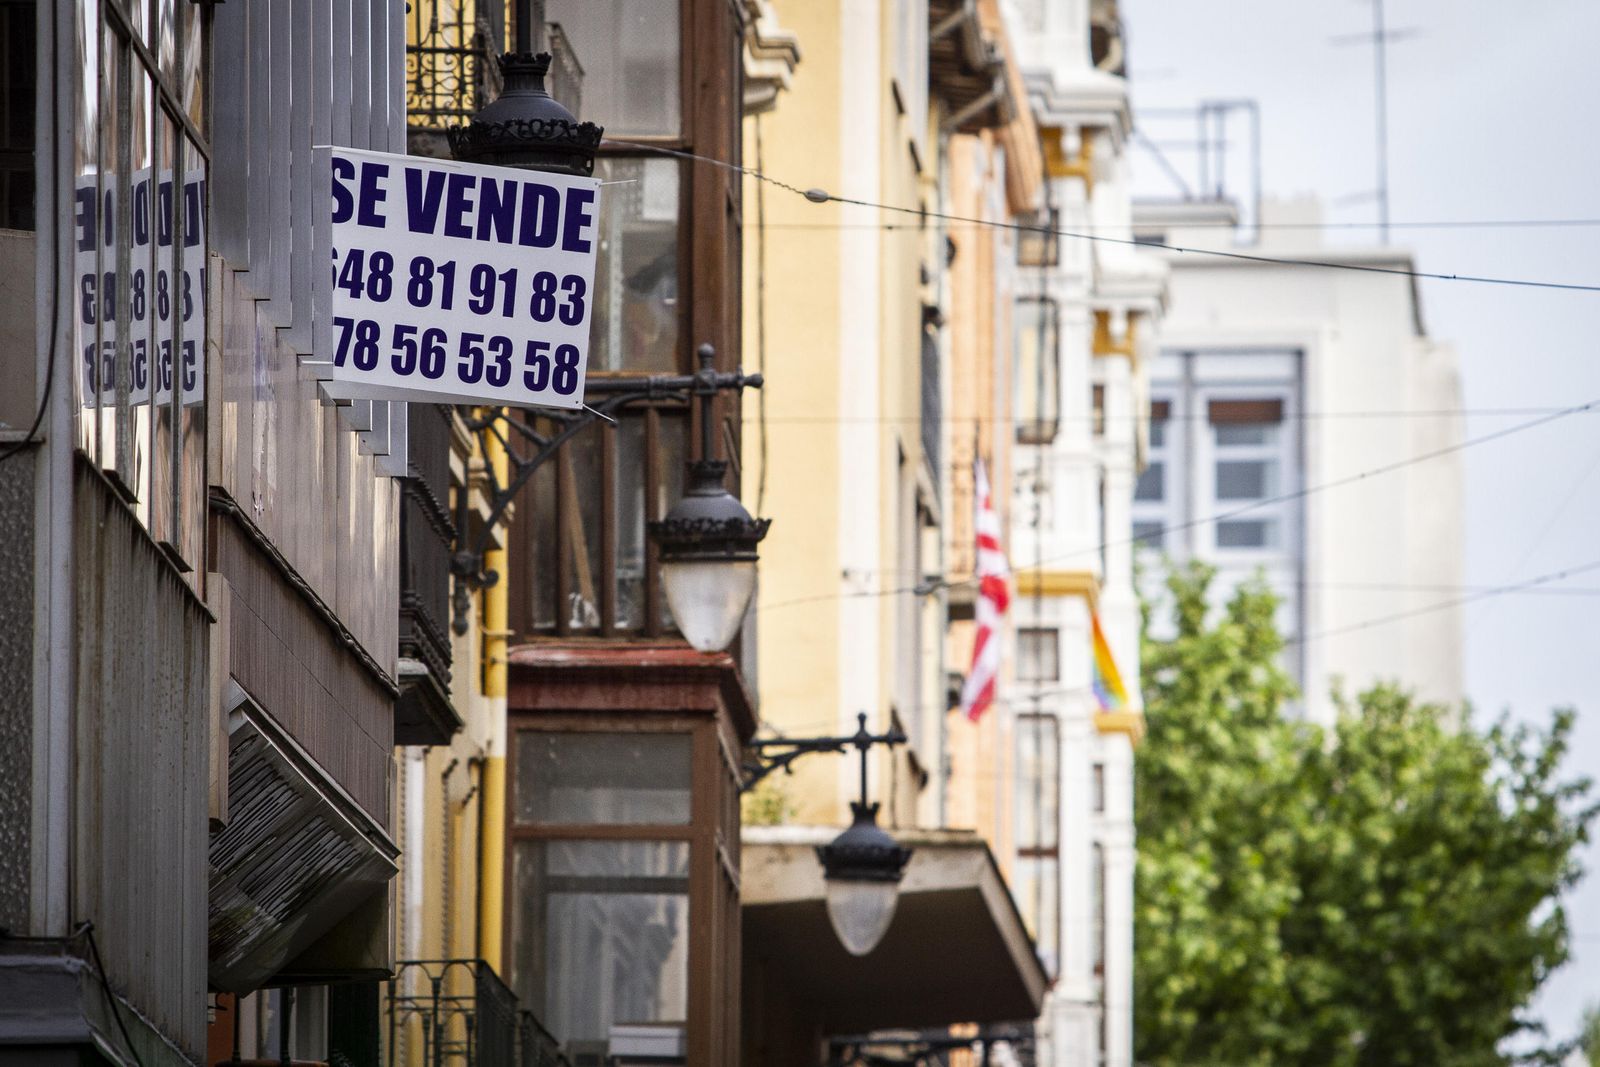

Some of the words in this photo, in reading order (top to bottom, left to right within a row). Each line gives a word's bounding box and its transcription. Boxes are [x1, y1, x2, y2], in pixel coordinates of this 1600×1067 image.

[331, 156, 390, 229] SE
[404, 167, 595, 254] VENDE
[331, 247, 394, 303] 48
[407, 255, 456, 311] 81
[468, 263, 518, 318] 91
[529, 271, 587, 327] 83
[390, 324, 448, 380] 56
[457, 332, 514, 388] 53
[523, 340, 580, 396] 58
